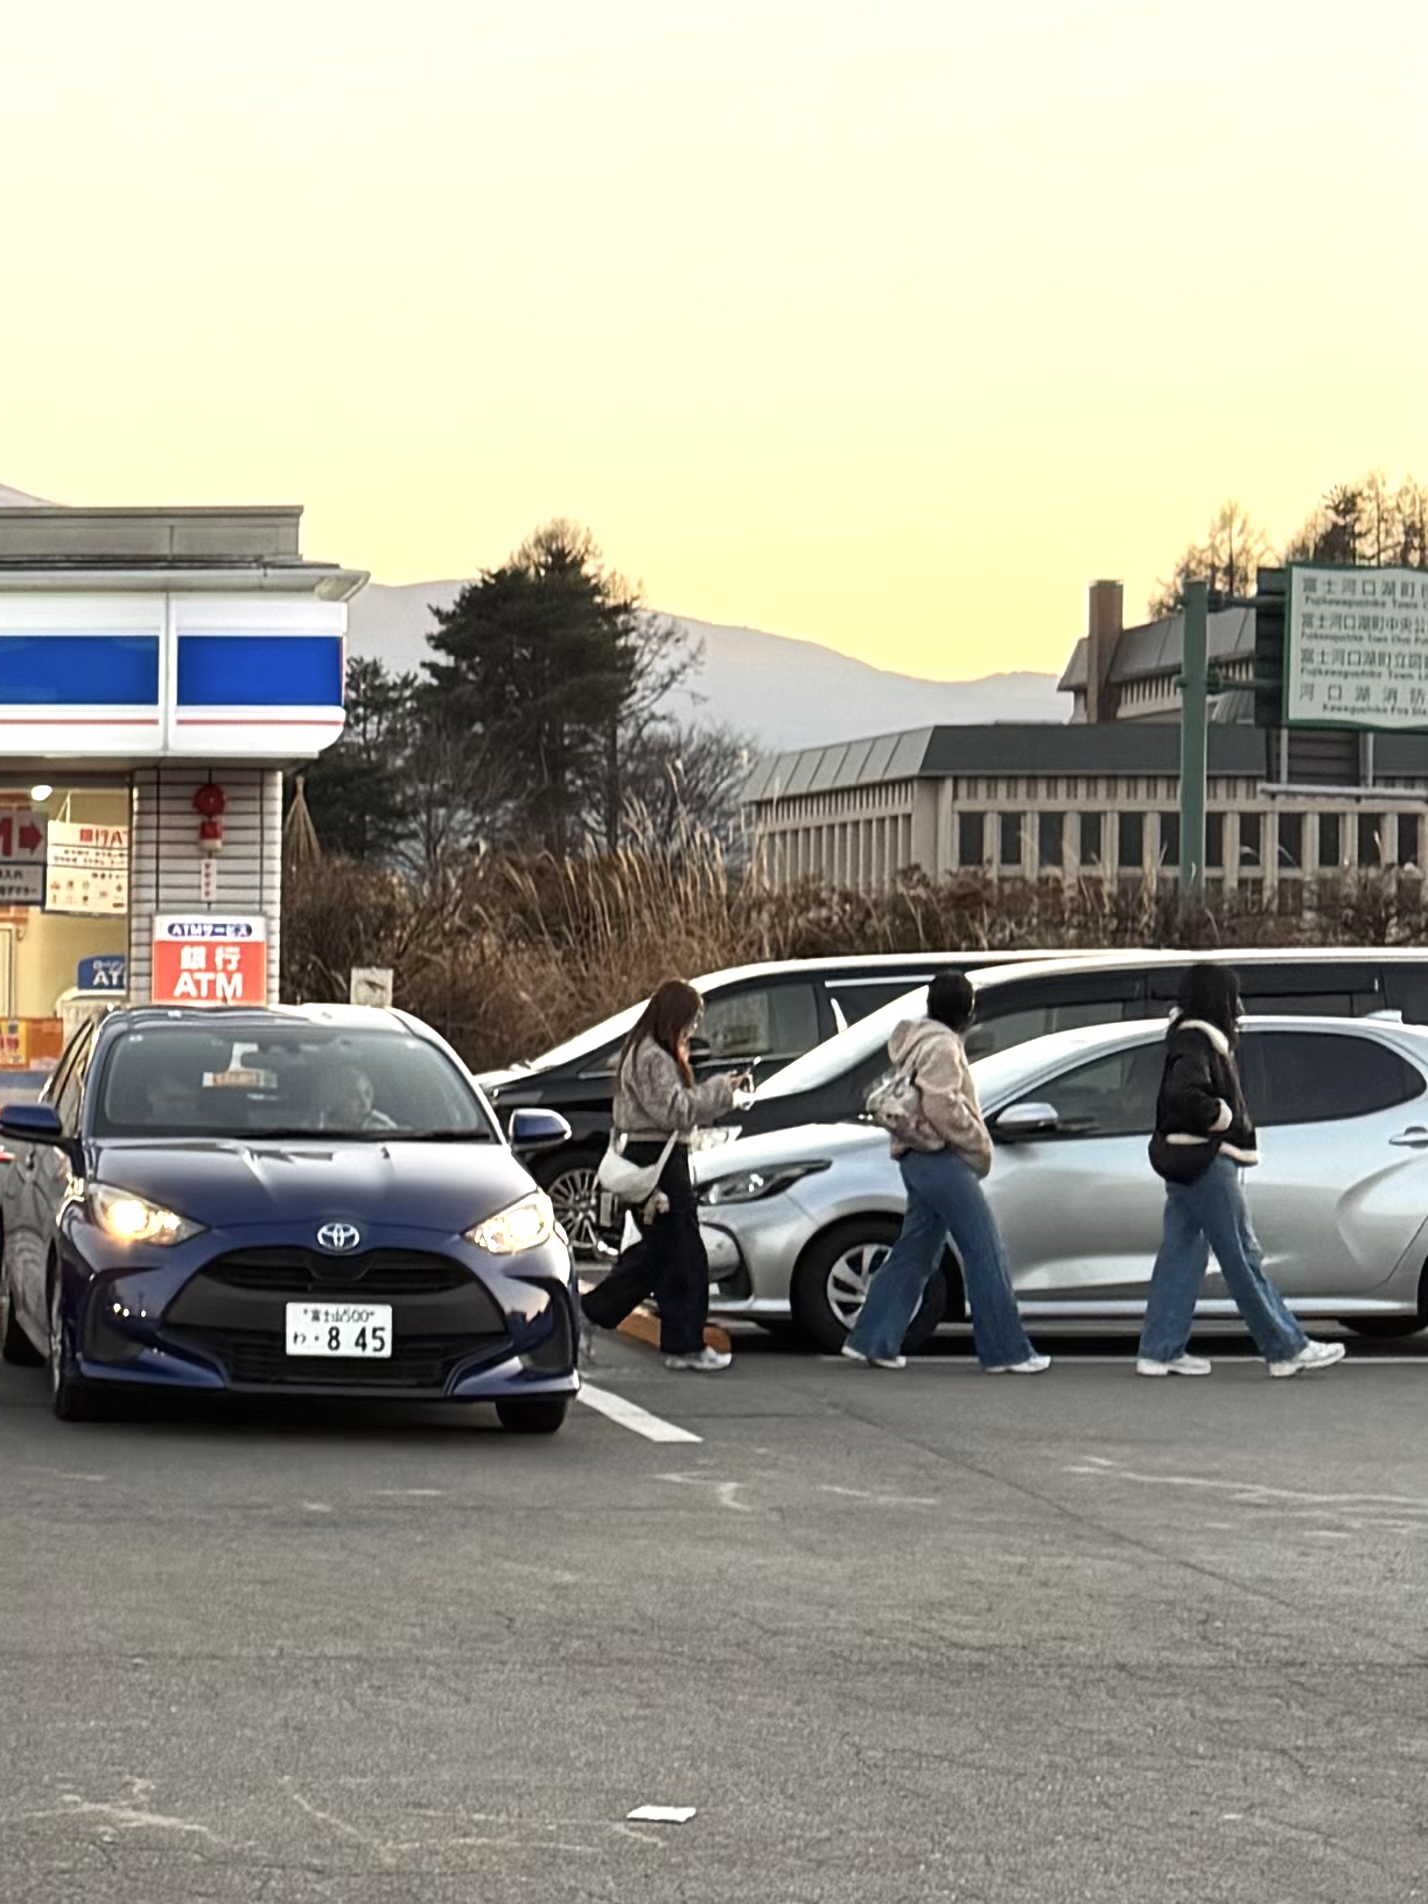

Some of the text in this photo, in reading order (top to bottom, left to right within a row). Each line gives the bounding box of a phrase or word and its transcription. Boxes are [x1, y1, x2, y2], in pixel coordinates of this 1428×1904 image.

[179, 945, 242, 971] 銀行
[93, 970, 126, 986] AT
[173, 971, 243, 999] ATM
